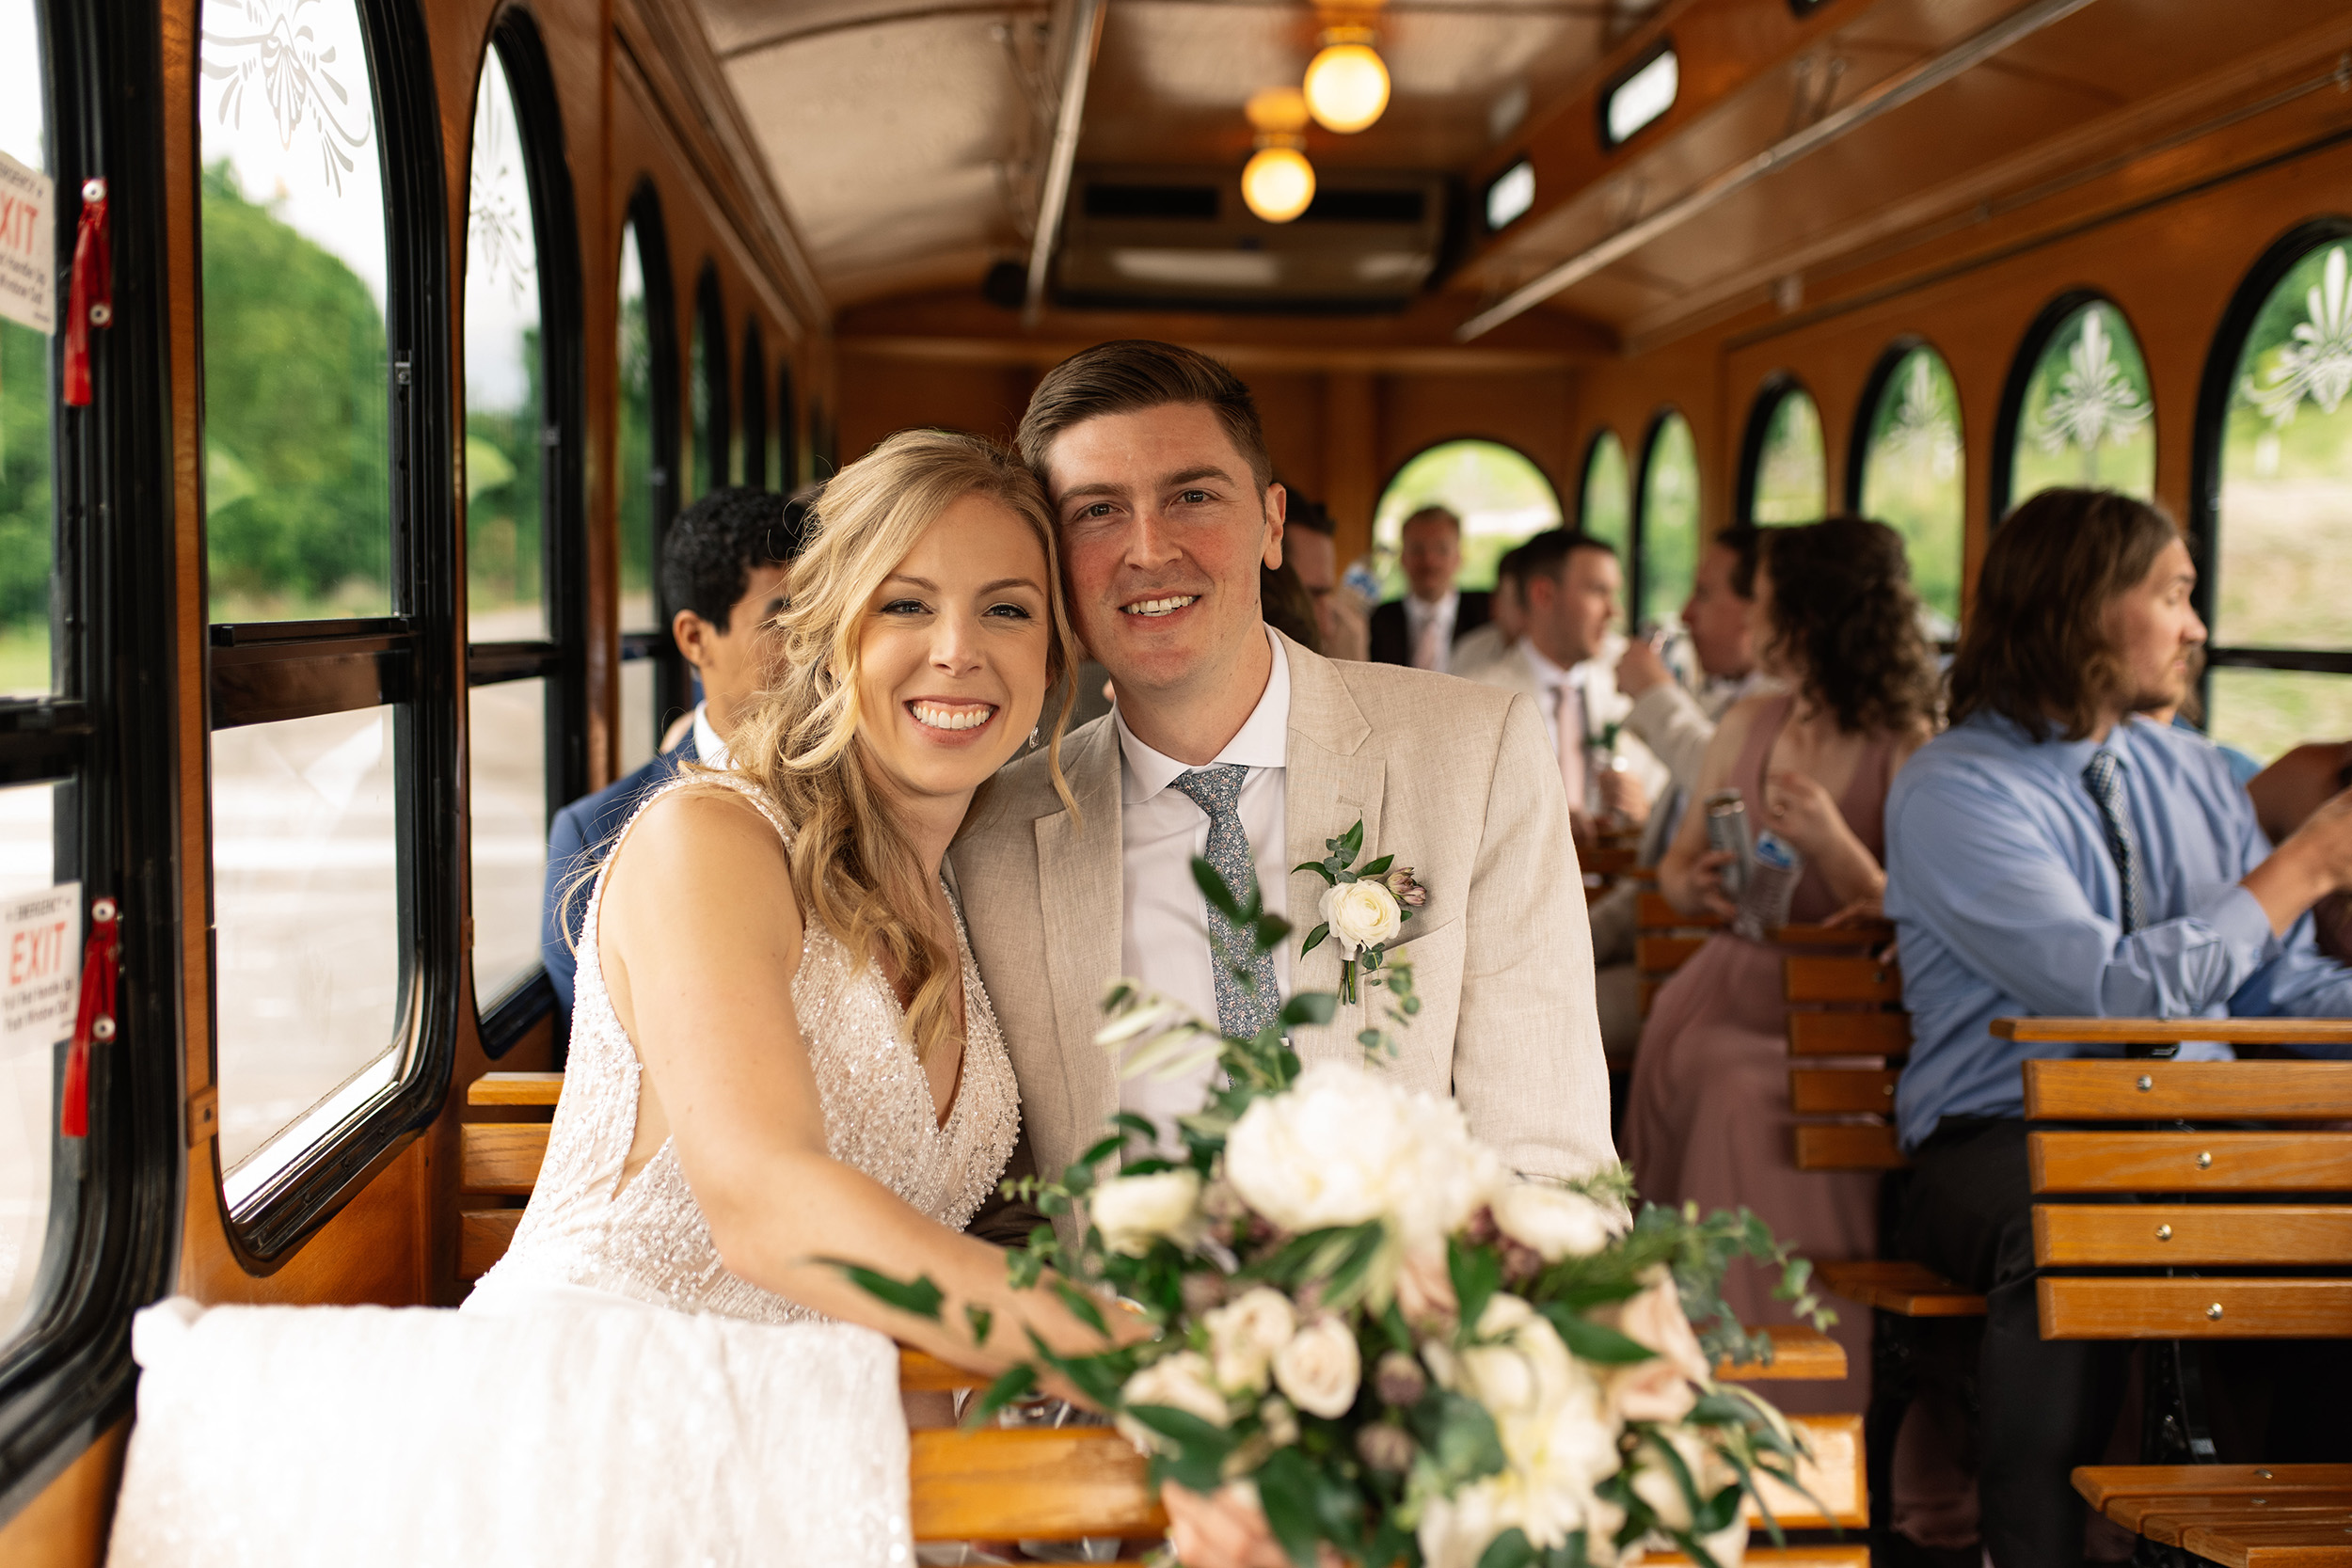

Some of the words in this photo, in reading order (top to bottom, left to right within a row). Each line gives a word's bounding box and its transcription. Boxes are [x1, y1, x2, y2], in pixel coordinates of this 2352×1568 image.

[0, 189, 40, 256] XIT
[14, 896, 63, 922] EMERGENCY
[8, 920, 67, 986] EXIT
